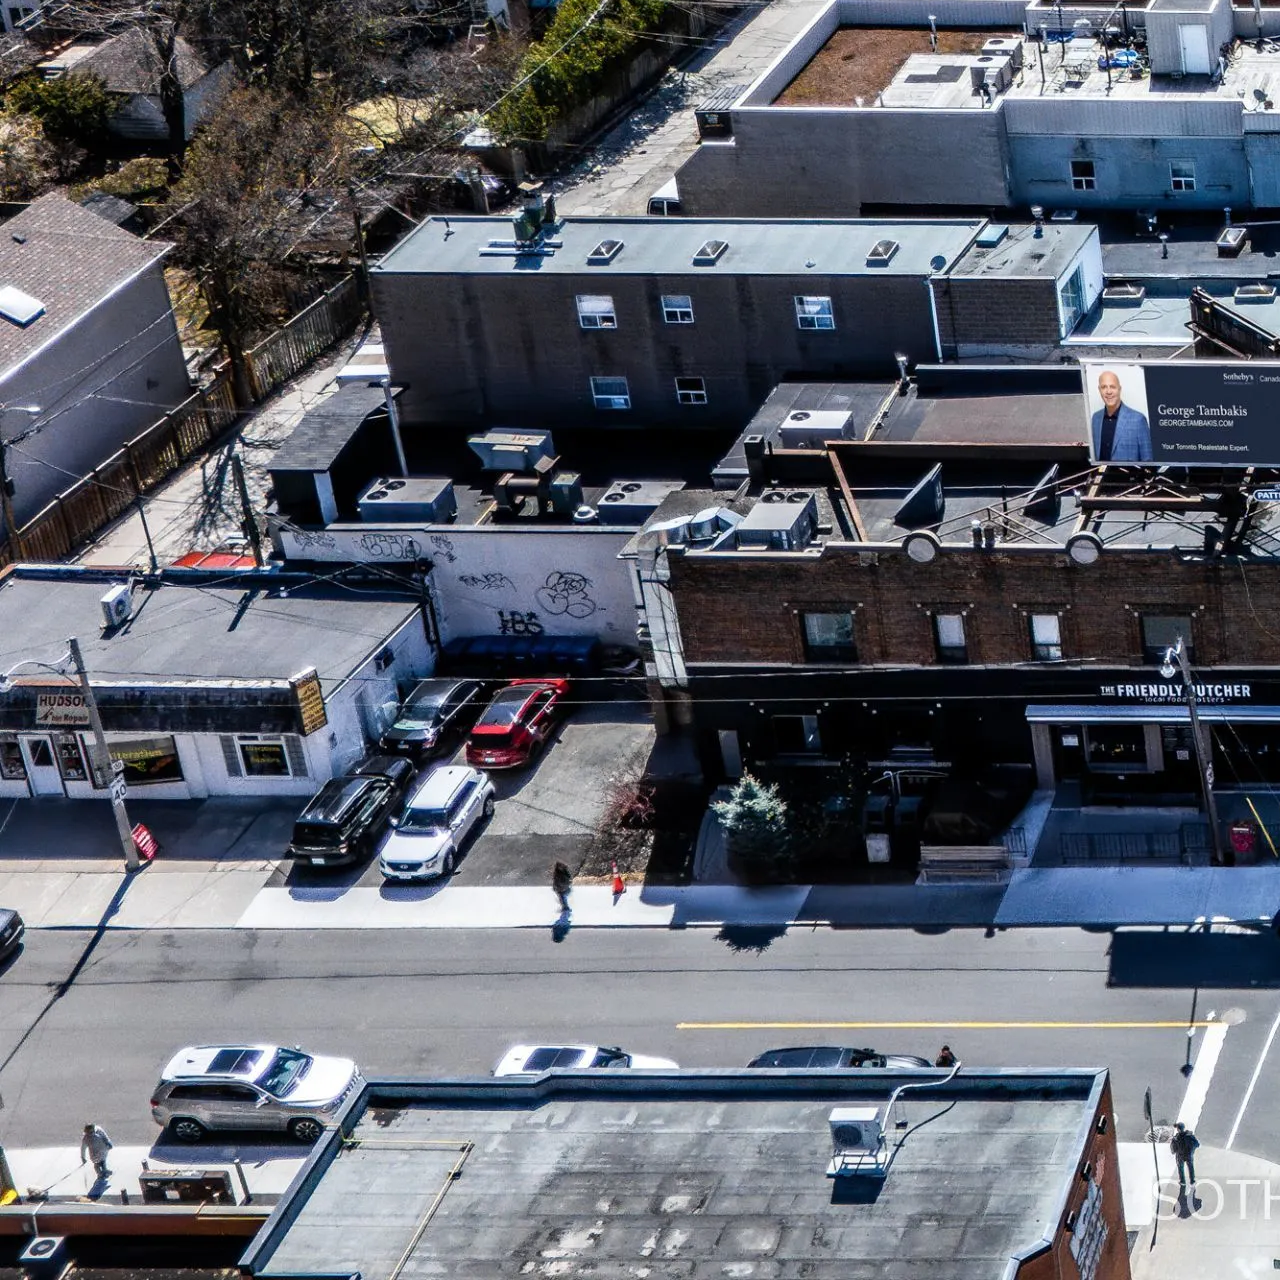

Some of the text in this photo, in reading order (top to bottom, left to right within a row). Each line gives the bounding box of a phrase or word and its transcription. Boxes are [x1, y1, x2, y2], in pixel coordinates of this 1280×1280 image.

[1223, 373, 1254, 382] Sotheby's
[1158, 404, 1248, 418] George Tambakis
[1159, 419, 1234, 427] GEORGETAMBAKIS.COM
[1118, 685, 1182, 696] FRIENDLY
